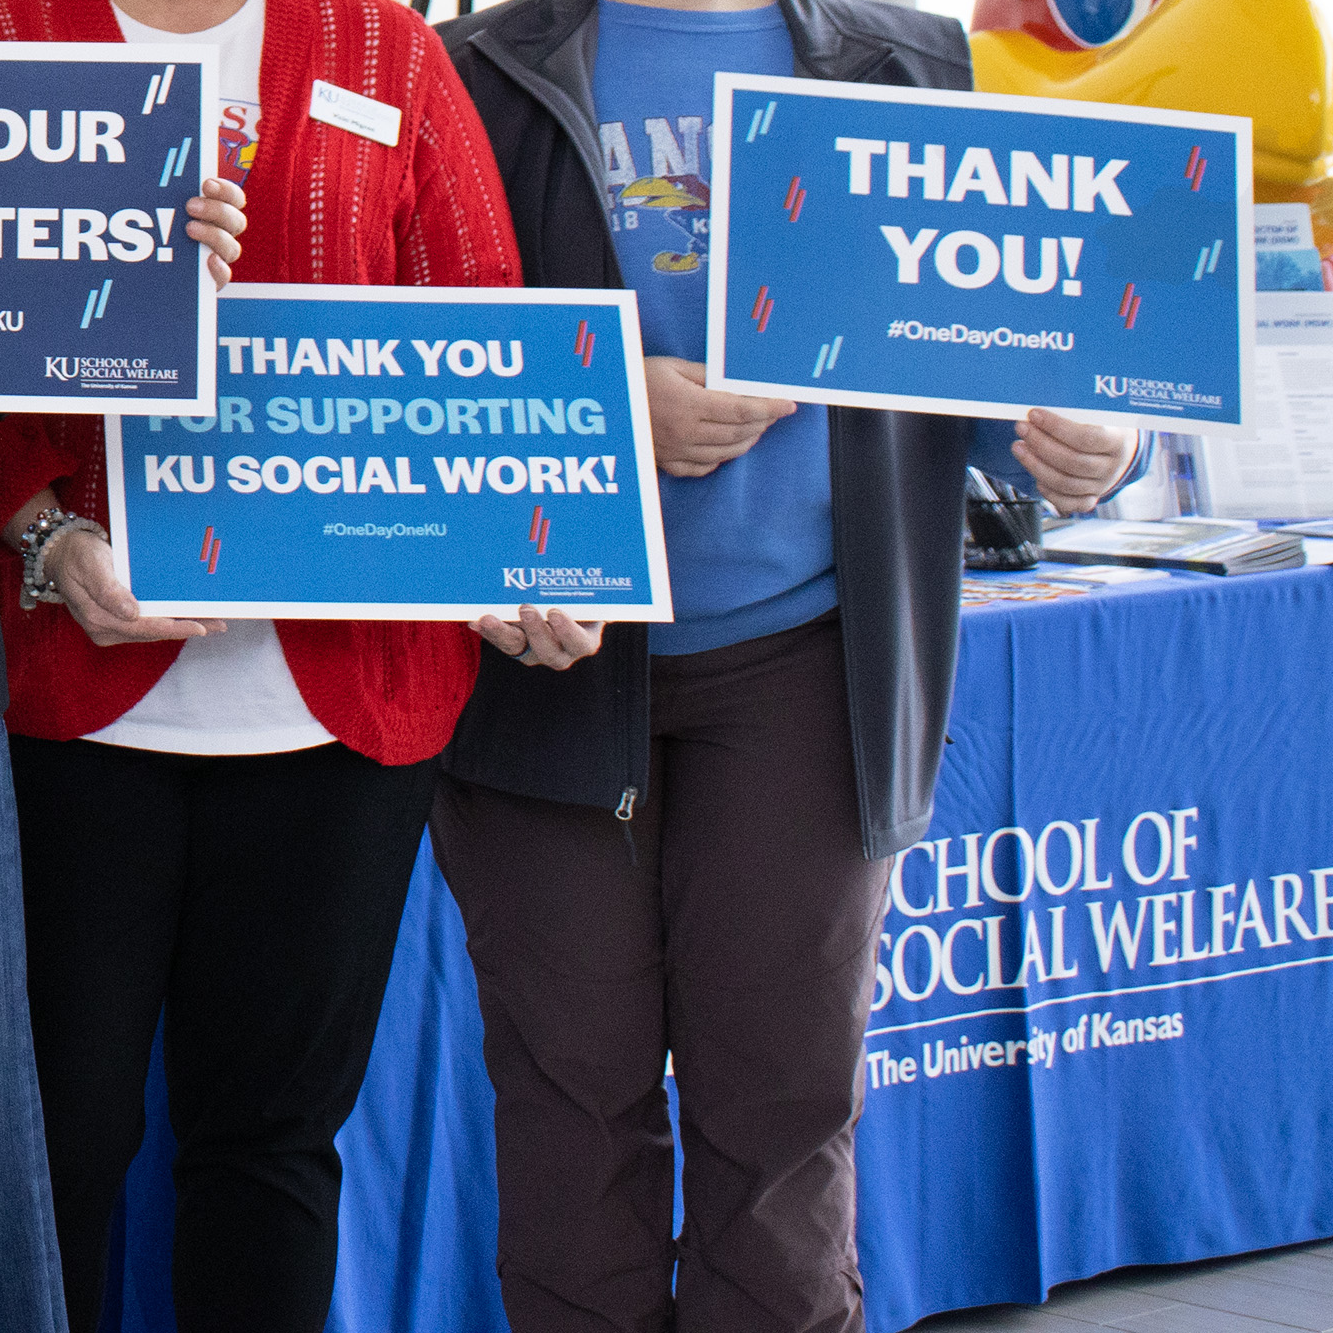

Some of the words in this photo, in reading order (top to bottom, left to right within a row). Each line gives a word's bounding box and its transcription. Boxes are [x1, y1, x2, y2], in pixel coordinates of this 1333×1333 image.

[834, 136, 1132, 216] THANK
[692, 218, 710, 234] K
[880, 224, 1084, 297] YOU!
[887, 319, 1075, 352] #OneDayOneKU
[45, 356, 80, 381] KU
[81, 357, 130, 368] SCHOOL
[132, 358, 149, 369] OF
[219, 337, 405, 376] THANK
[410, 339, 523, 376] YOU
[81, 368, 124, 378] SOCIAL
[127, 369, 179, 380] WELFARE
[1094, 374, 1129, 399] KU
[1129, 378, 1175, 391] SCHOOL
[1177, 382, 1194, 393] OF
[1129, 388, 1171, 400] SOCIAL
[1172, 390, 1223, 405] WELFARE
[266, 398, 606, 435] SUPPORTING
[144, 455, 215, 493] KU
[227, 456, 426, 494] SOCIAL
[434, 456, 619, 494] WORK!
[323, 522, 447, 538] #OneDayOneKU
[502, 567, 537, 590] KU
[538, 567, 584, 577] SCHOOL
[586, 567, 603, 577] OF
[538, 577, 579, 586] SOCIAL
[581, 577, 633, 586] WELFARE
[883, 818, 1113, 918] CHOOL
[1122, 807, 1199, 885] OF
[1088, 868, 1333, 973] WELFARE
[867, 1050, 916, 1089] The
[923, 1028, 1057, 1078] University
[1062, 1015, 1090, 1053] of
[1091, 1011, 1184, 1049] Kansas
